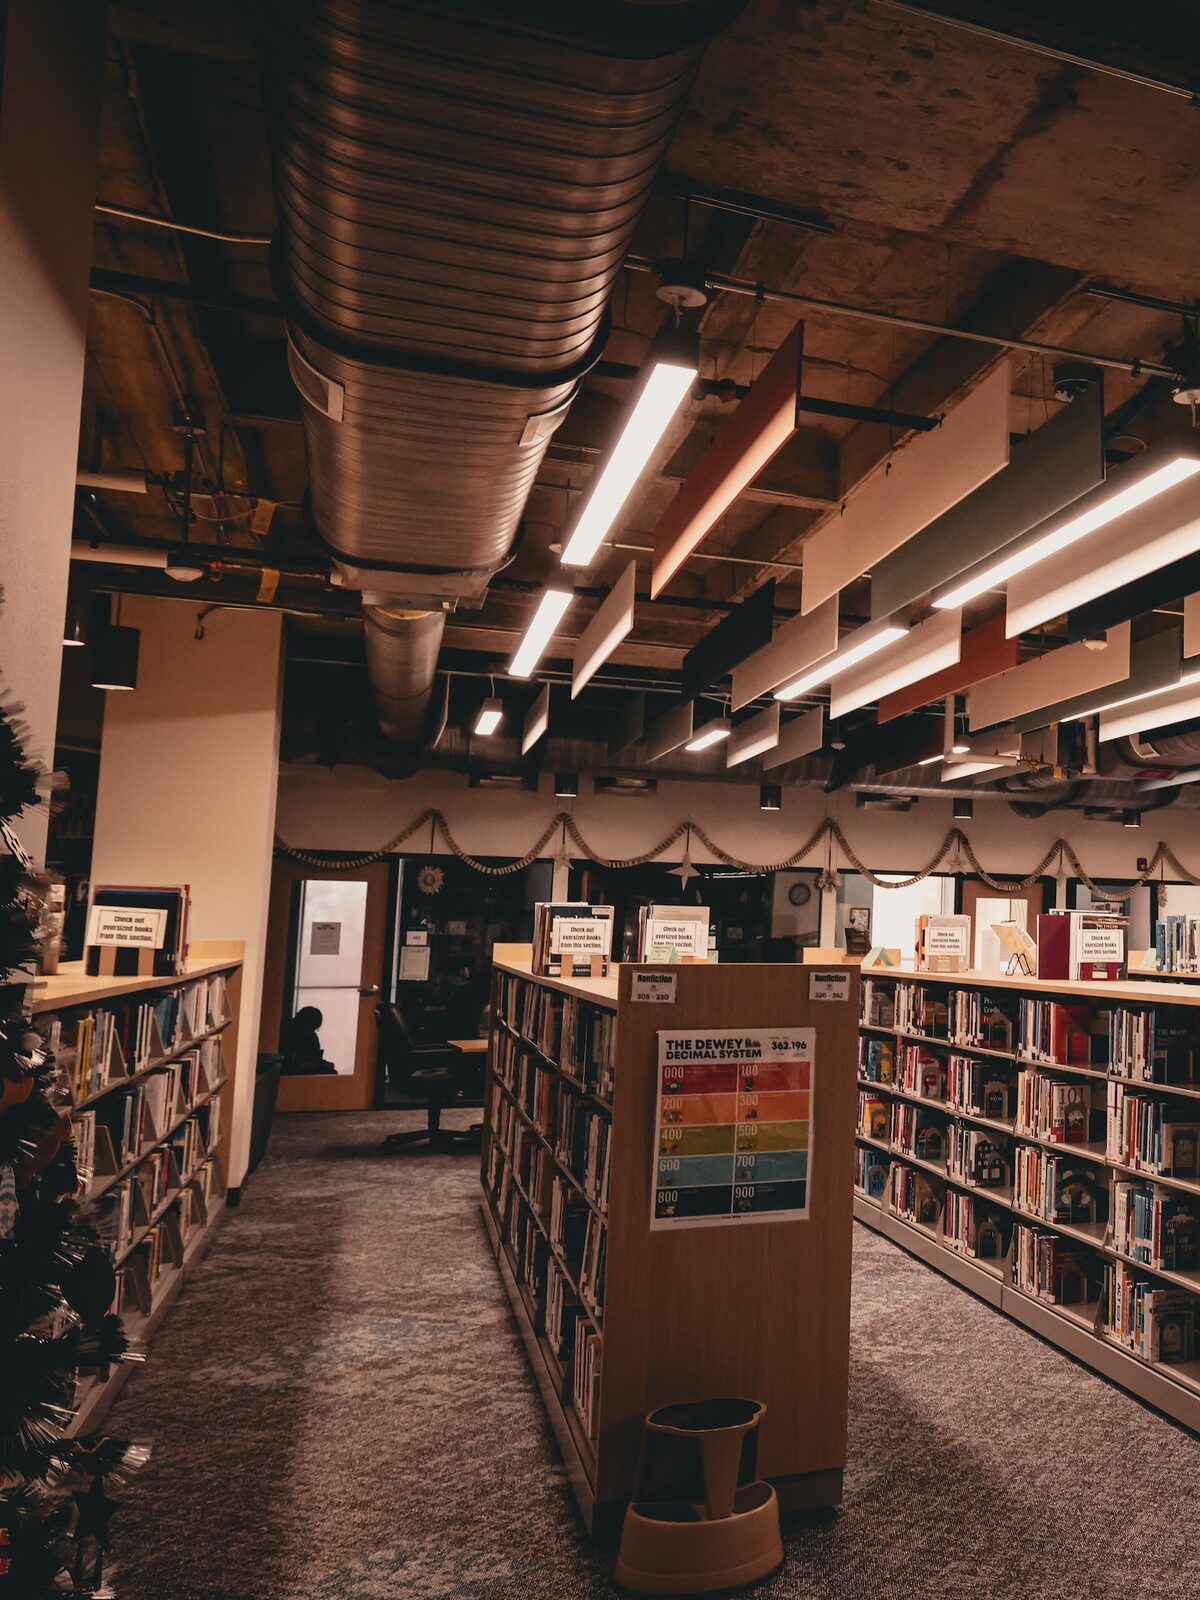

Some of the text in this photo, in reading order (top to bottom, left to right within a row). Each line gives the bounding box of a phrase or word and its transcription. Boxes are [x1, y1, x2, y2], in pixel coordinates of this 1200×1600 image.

[103, 924, 133, 932] oversized
[637, 974, 673, 984] Nonfiction
[815, 974, 847, 983] Nonfiction
[656, 993, 669, 1001] 330
[666, 1038, 743, 1051] THE DEWEY
[771, 1040, 807, 1051] 362.196
[666, 1048, 762, 1060] DECIMAL SYSTEM
[664, 1066, 684, 1079] 000
[740, 1064, 758, 1077] 100
[739, 1094, 759, 1106] 300
[1060, 1088, 1083, 1104] 101
[662, 1097, 683, 1110] 200
[661, 1128, 683, 1140] 400
[738, 1124, 758, 1137] 500
[659, 1159, 681, 1171] 600
[736, 1155, 756, 1168] 700
[657, 1190, 679, 1204] 800
[734, 1186, 755, 1199] 900
